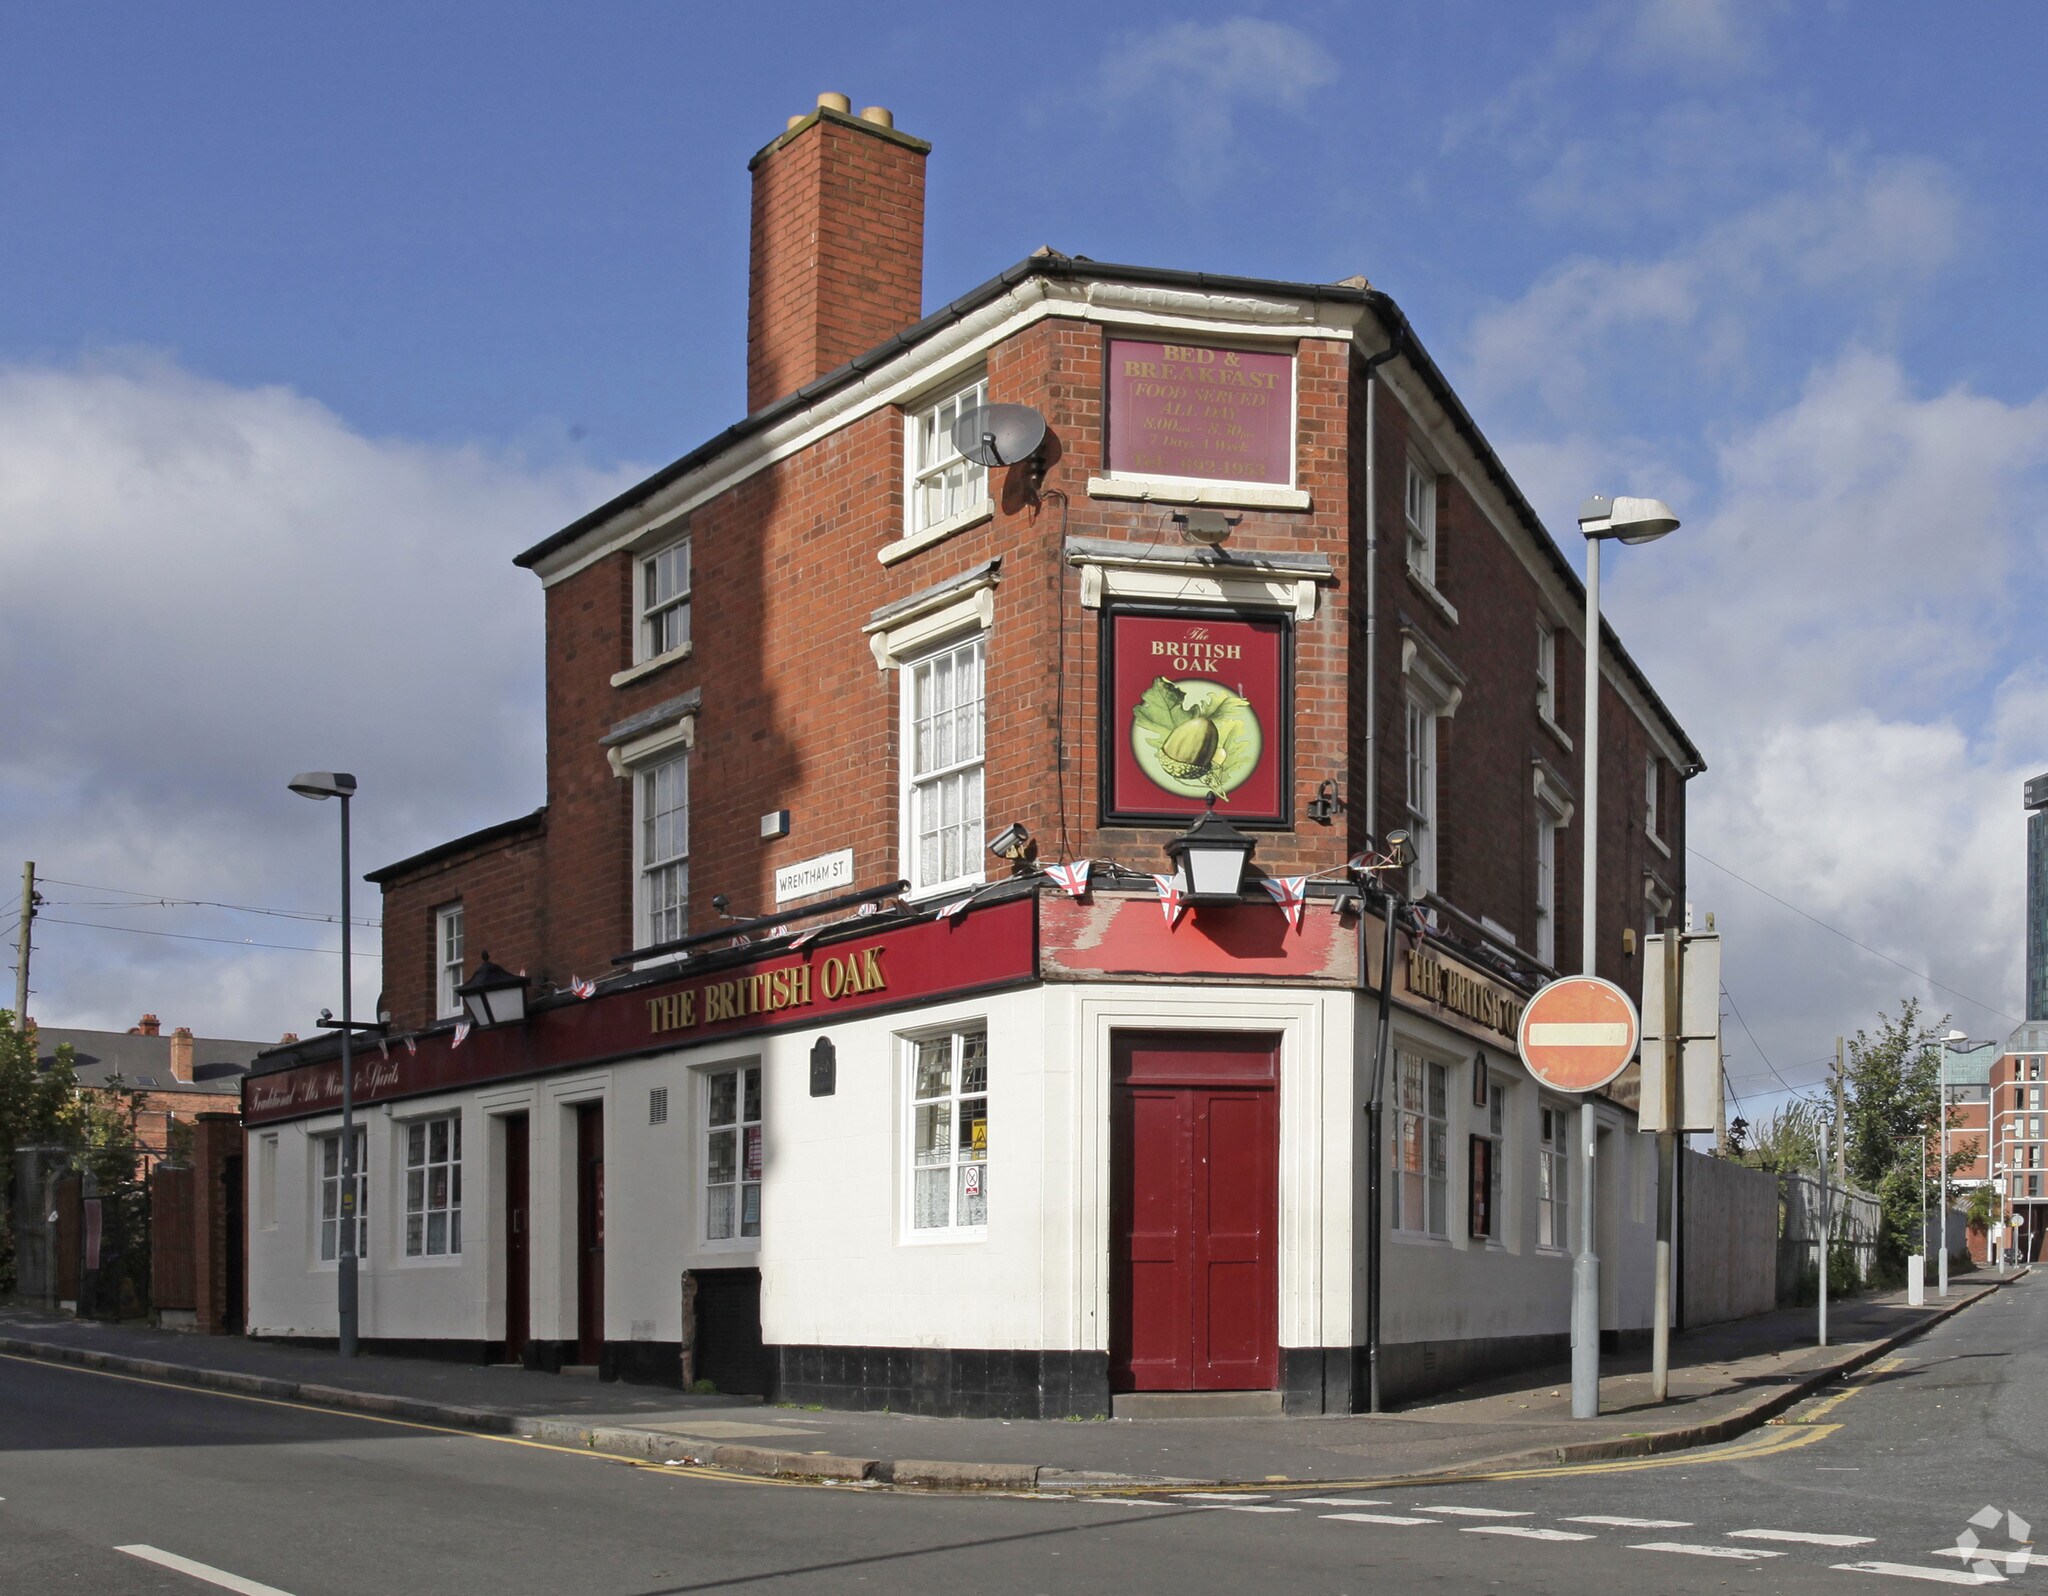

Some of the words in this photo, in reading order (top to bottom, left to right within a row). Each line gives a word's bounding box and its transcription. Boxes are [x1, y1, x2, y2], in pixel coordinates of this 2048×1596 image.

[1162, 345, 1215, 364] BED
[1223, 351, 1241, 367] &
[1123, 361, 1280, 390] BREAKFAST
[1135, 382, 1187, 400] FOOD
[1195, 387, 1266, 408] SERVED
[1160, 401, 1197, 417] ALL
[1203, 405, 1239, 420] DAY
[1150, 433, 1158, 445] 7
[1163, 435, 1195, 451] Days
[1215, 439, 1249, 452] Week
[1184, 627, 1210, 640] The
[1151, 641, 1241, 659] BRITISH
[1173, 657, 1219, 672] OAK
[779, 864, 830, 892] WRENTHAM
[832, 860, 844, 877] ST
[646, 989, 696, 1034] THE
[704, 963, 812, 1023] BRITISH
[820, 945, 887, 999] OAK
[1408, 948, 1444, 1003] THE
[1446, 968, 1503, 1031] BRITISH
[249, 1081, 297, 1111] Traditional
[299, 1076, 319, 1102] Ales
[365, 1061, 399, 1098] Spirits
